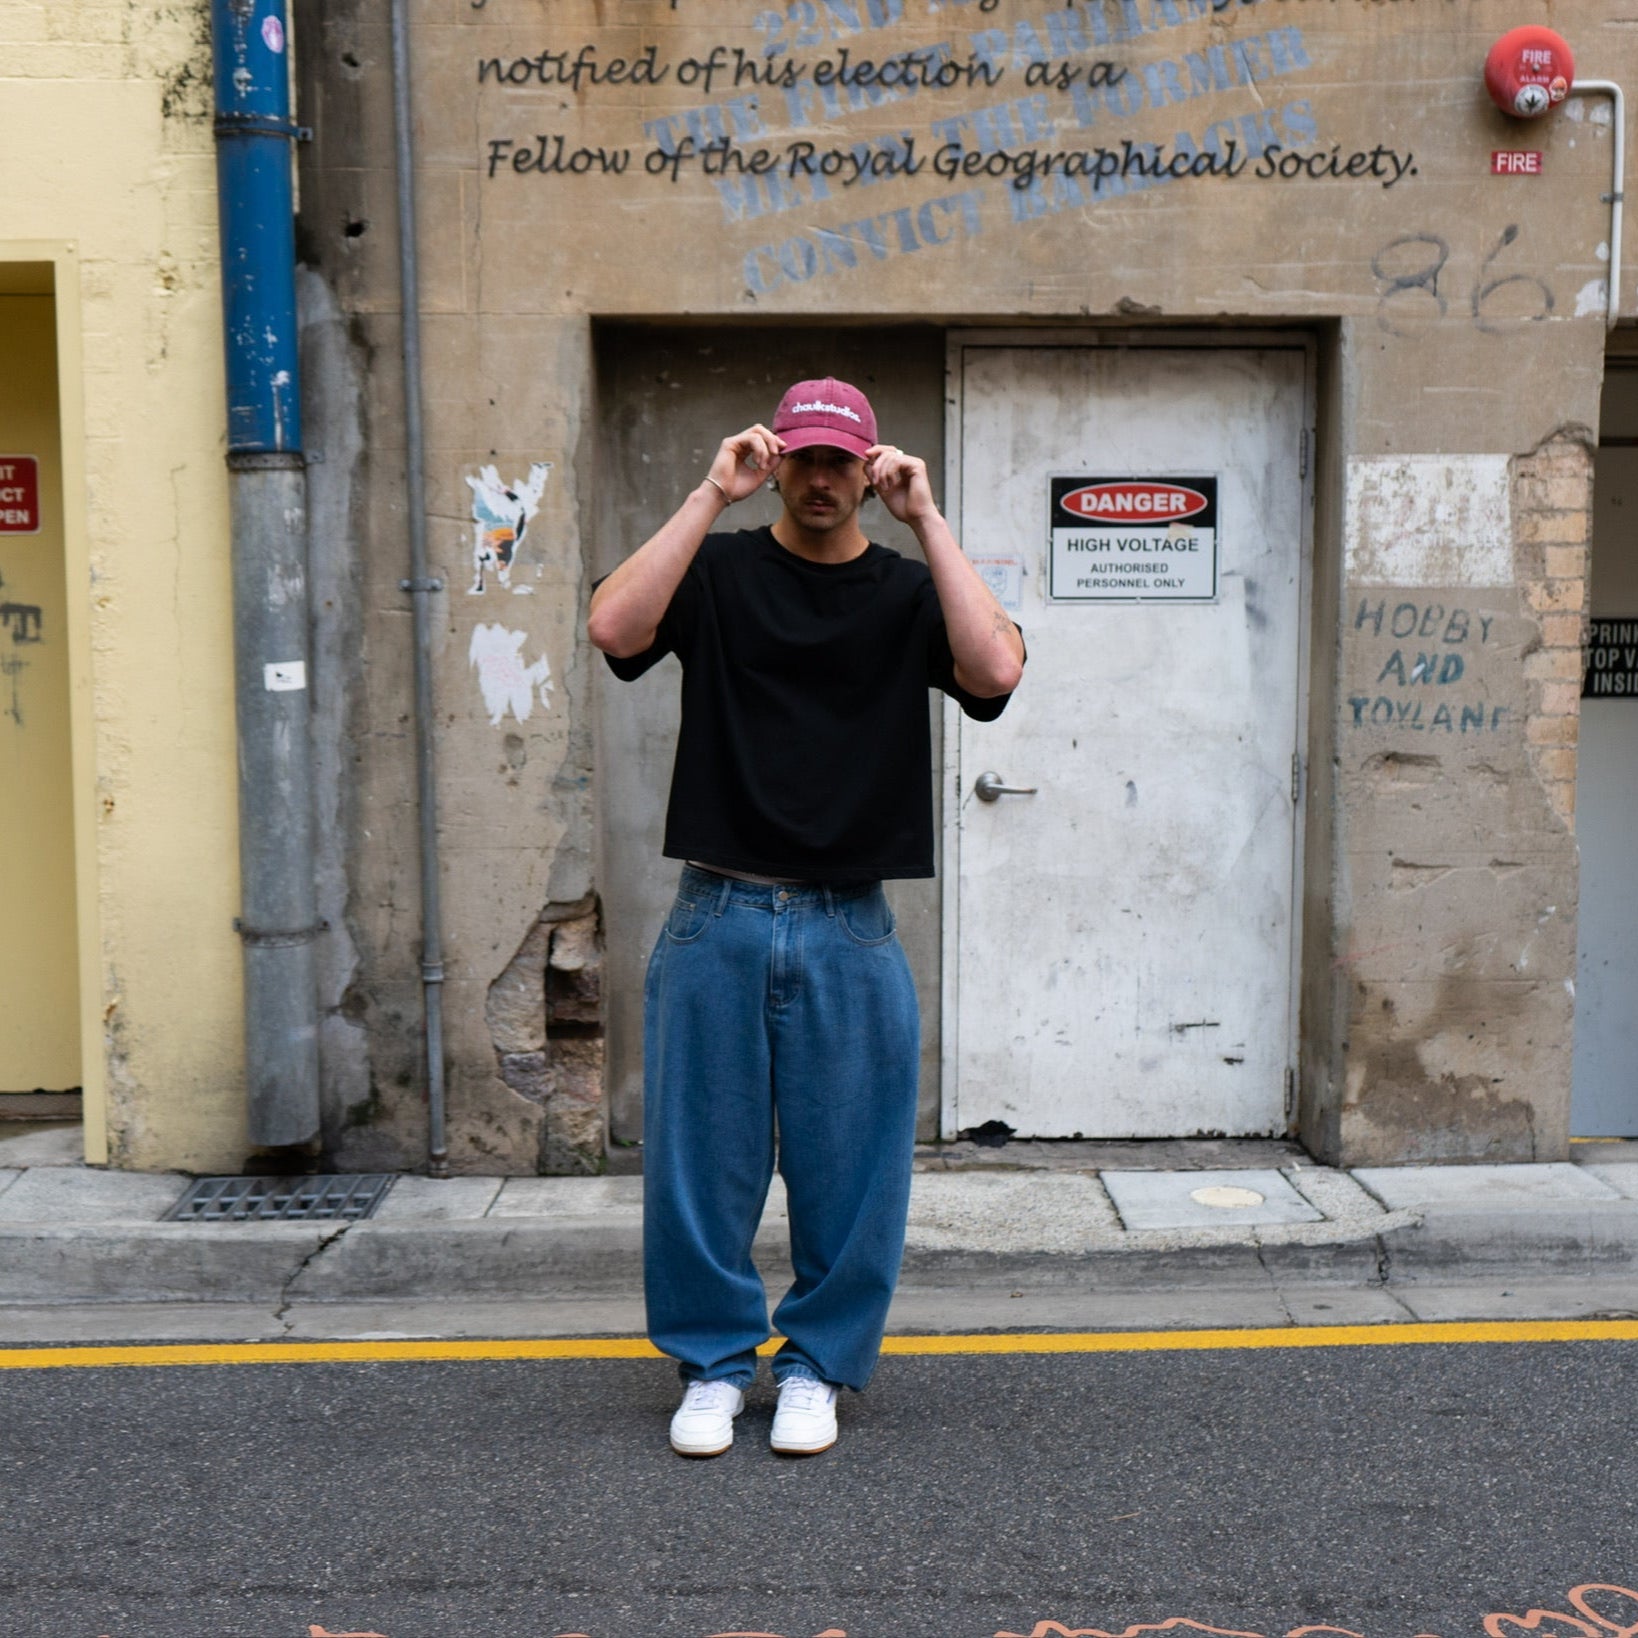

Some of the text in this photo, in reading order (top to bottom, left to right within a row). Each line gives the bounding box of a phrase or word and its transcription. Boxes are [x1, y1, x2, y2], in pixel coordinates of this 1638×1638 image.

[1522, 49, 1552, 65] FIRE
[478, 45, 1128, 93] notified of his election as a
[930, 94, 1056, 162] THE
[1068, 25, 1313, 130] FORMER
[644, 94, 768, 159] THE
[487, 135, 1419, 190] Fellow of the Royal Geographical Society.
[1496, 152, 1538, 173] FIRE
[743, 189, 987, 295] CONVICT
[0, 487, 25, 502] CT
[1080, 493, 1187, 512] DANGER
[1067, 538, 1200, 552] HIGH VOLTAGE
[1090, 563, 1169, 574] AUTHORISED
[1077, 578, 1186, 589] PERSONNEL ONLY
[1376, 649, 1465, 687] AND
[1584, 647, 1621, 670] TOP
